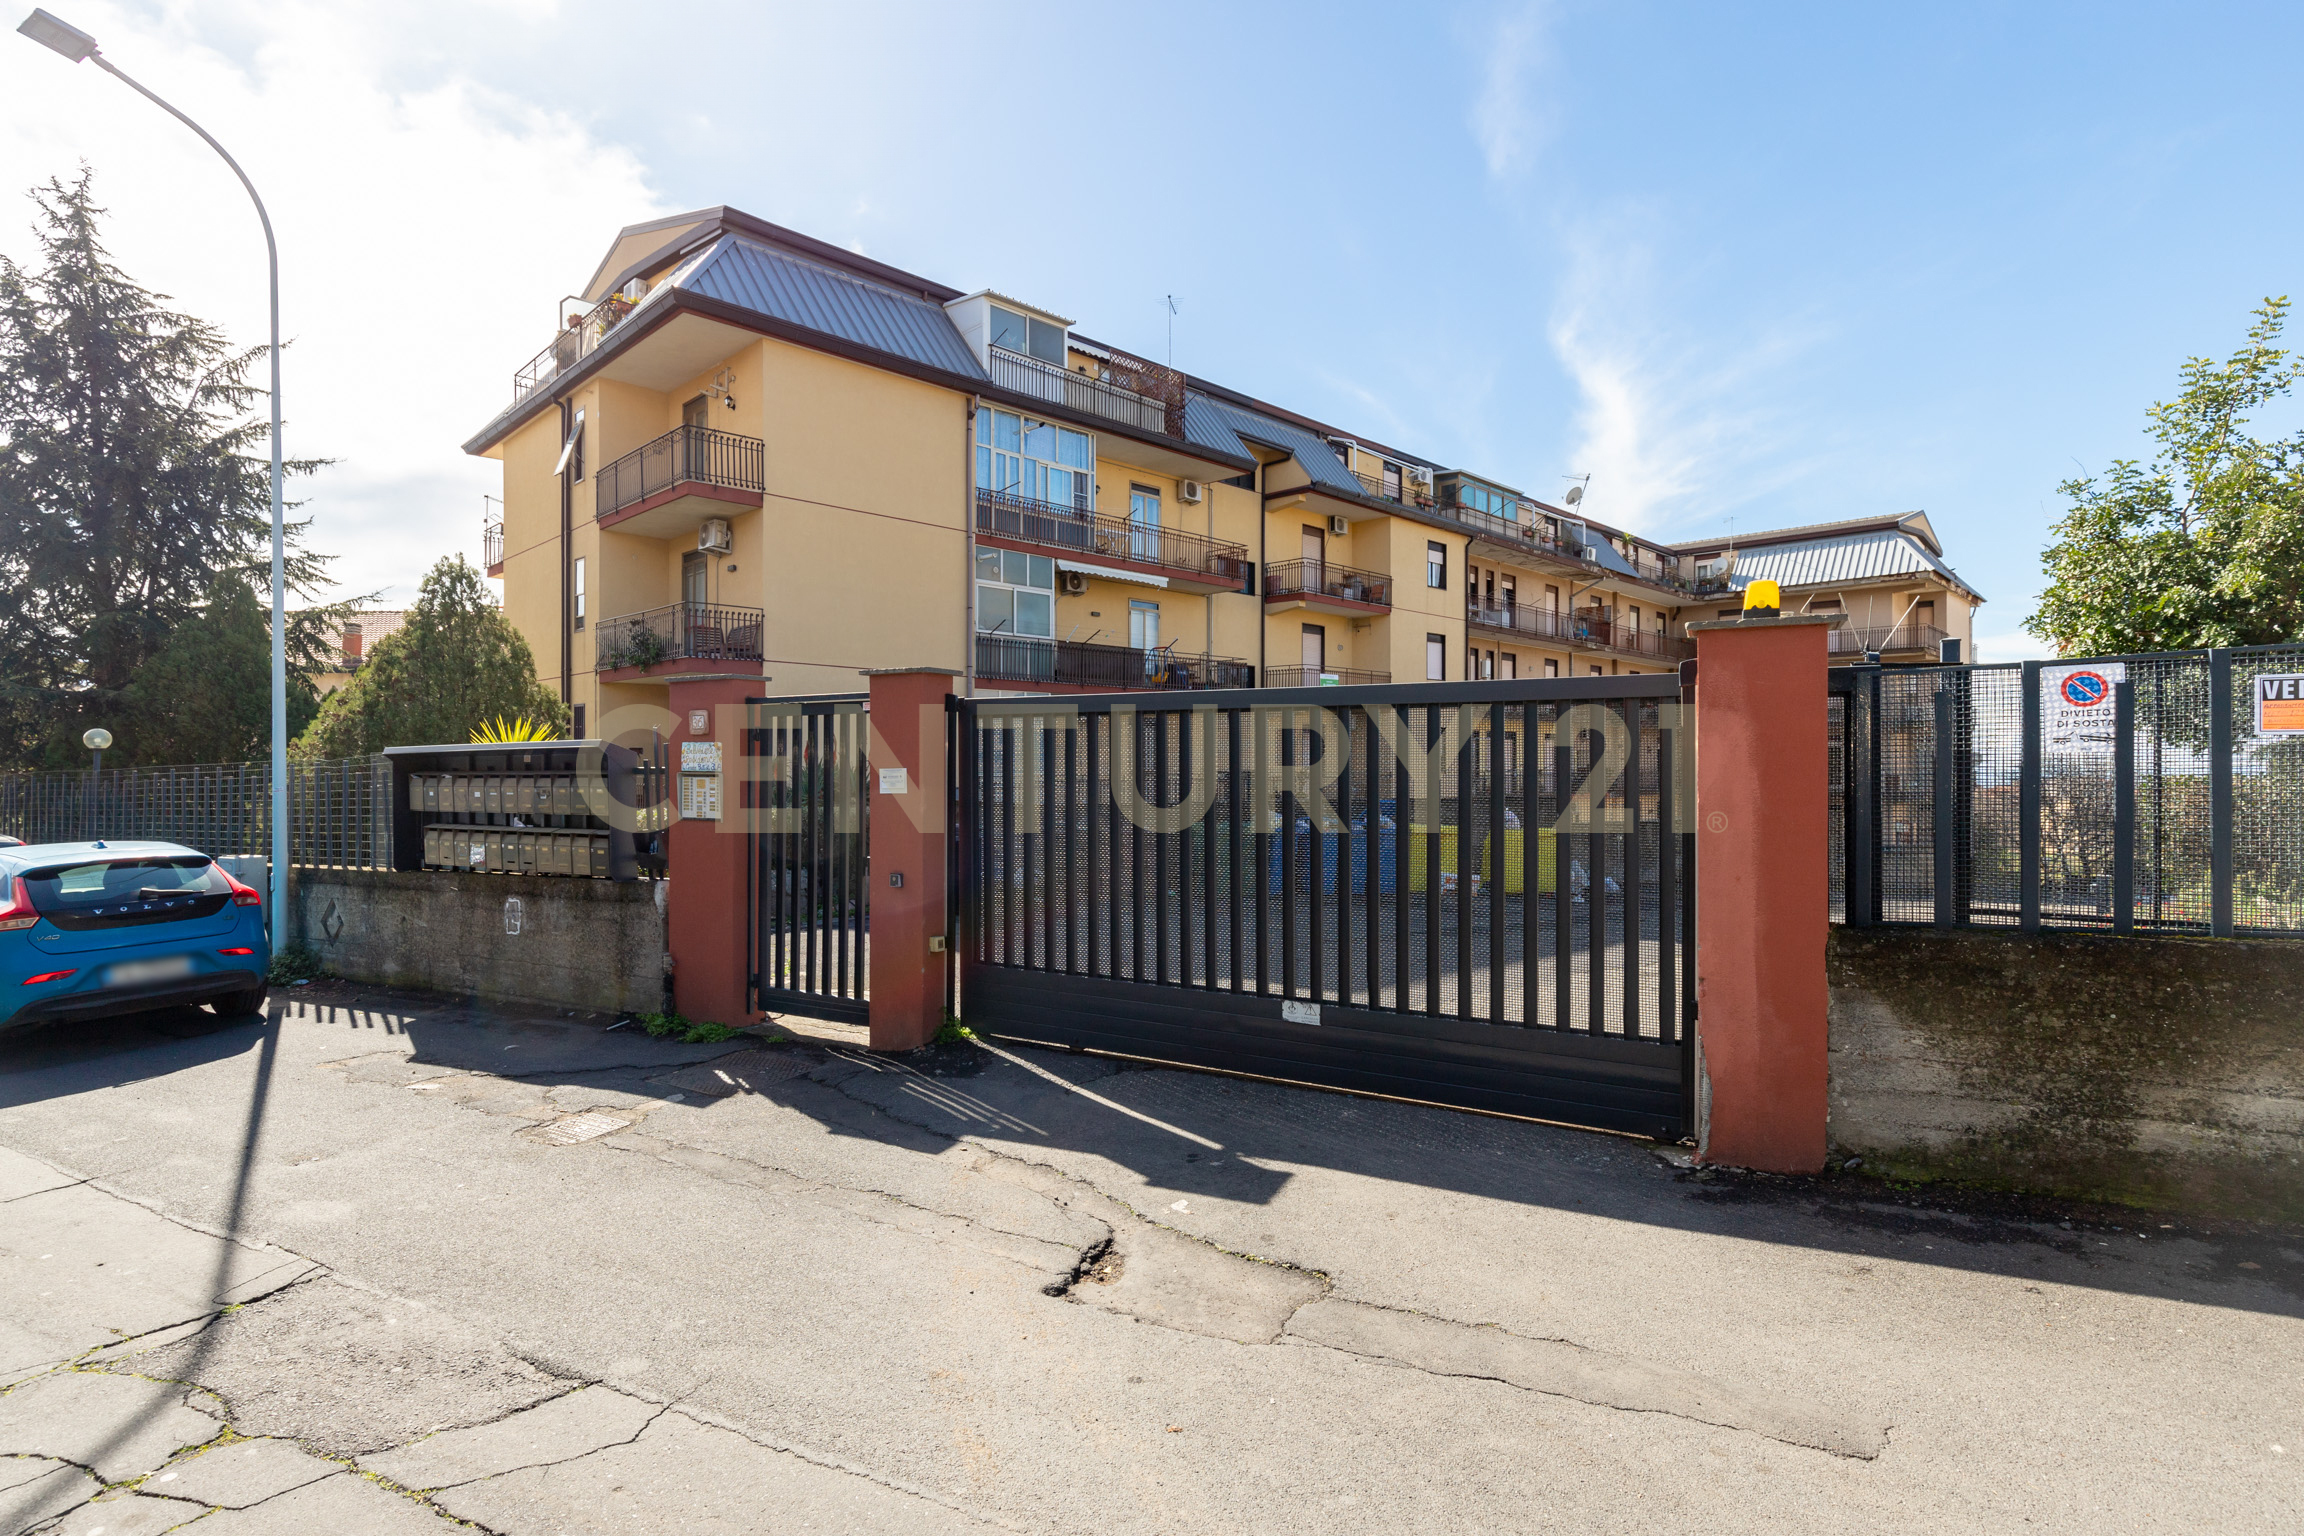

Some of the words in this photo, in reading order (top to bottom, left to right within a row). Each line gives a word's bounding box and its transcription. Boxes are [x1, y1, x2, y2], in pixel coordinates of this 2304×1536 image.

[2060, 709, 2111, 718] DIVIETO
[2056, 720, 2069, 728] DI
[2073, 719, 2115, 728] SOSTA
[92, 899, 196, 915] VOLVO
[36, 934, 61, 942] V40
